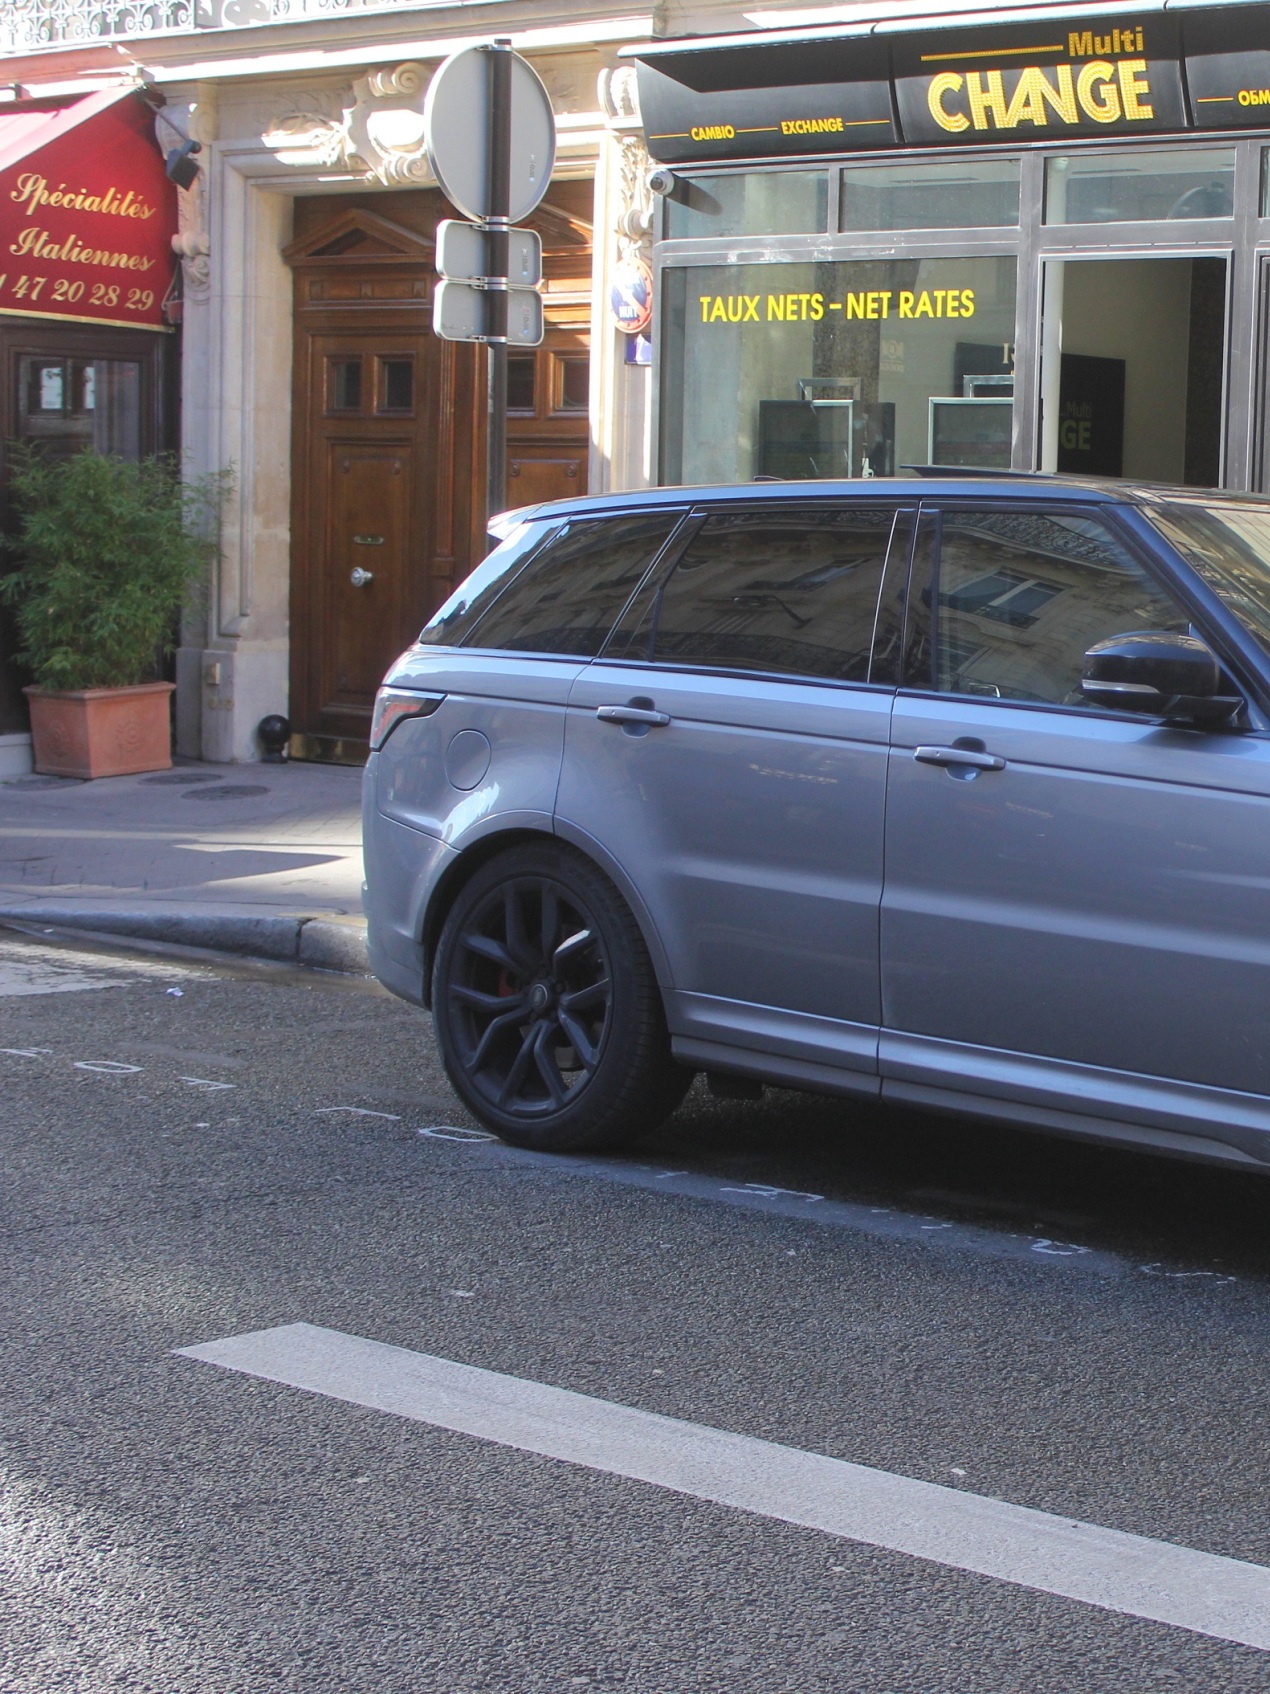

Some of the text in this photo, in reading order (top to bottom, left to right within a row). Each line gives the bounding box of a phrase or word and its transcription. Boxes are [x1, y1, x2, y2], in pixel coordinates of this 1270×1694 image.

[1068, 26, 1144, 56] Multi
[927, 58, 1155, 133] CHANGE
[690, 117, 844, 141] CAMBIO EXCHANGE
[10, 173, 157, 220] Spécialités
[9, 227, 157, 271] Italiennes
[11, 275, 47, 300] 47
[51, 279, 85, 303] 20
[89, 283, 120, 307] 28
[124, 288, 154, 311] 29
[700, 295, 761, 322] TAUX
[767, 293, 824, 321] NETS
[846, 291, 892, 319] NET
[899, 289, 975, 318] RATES
